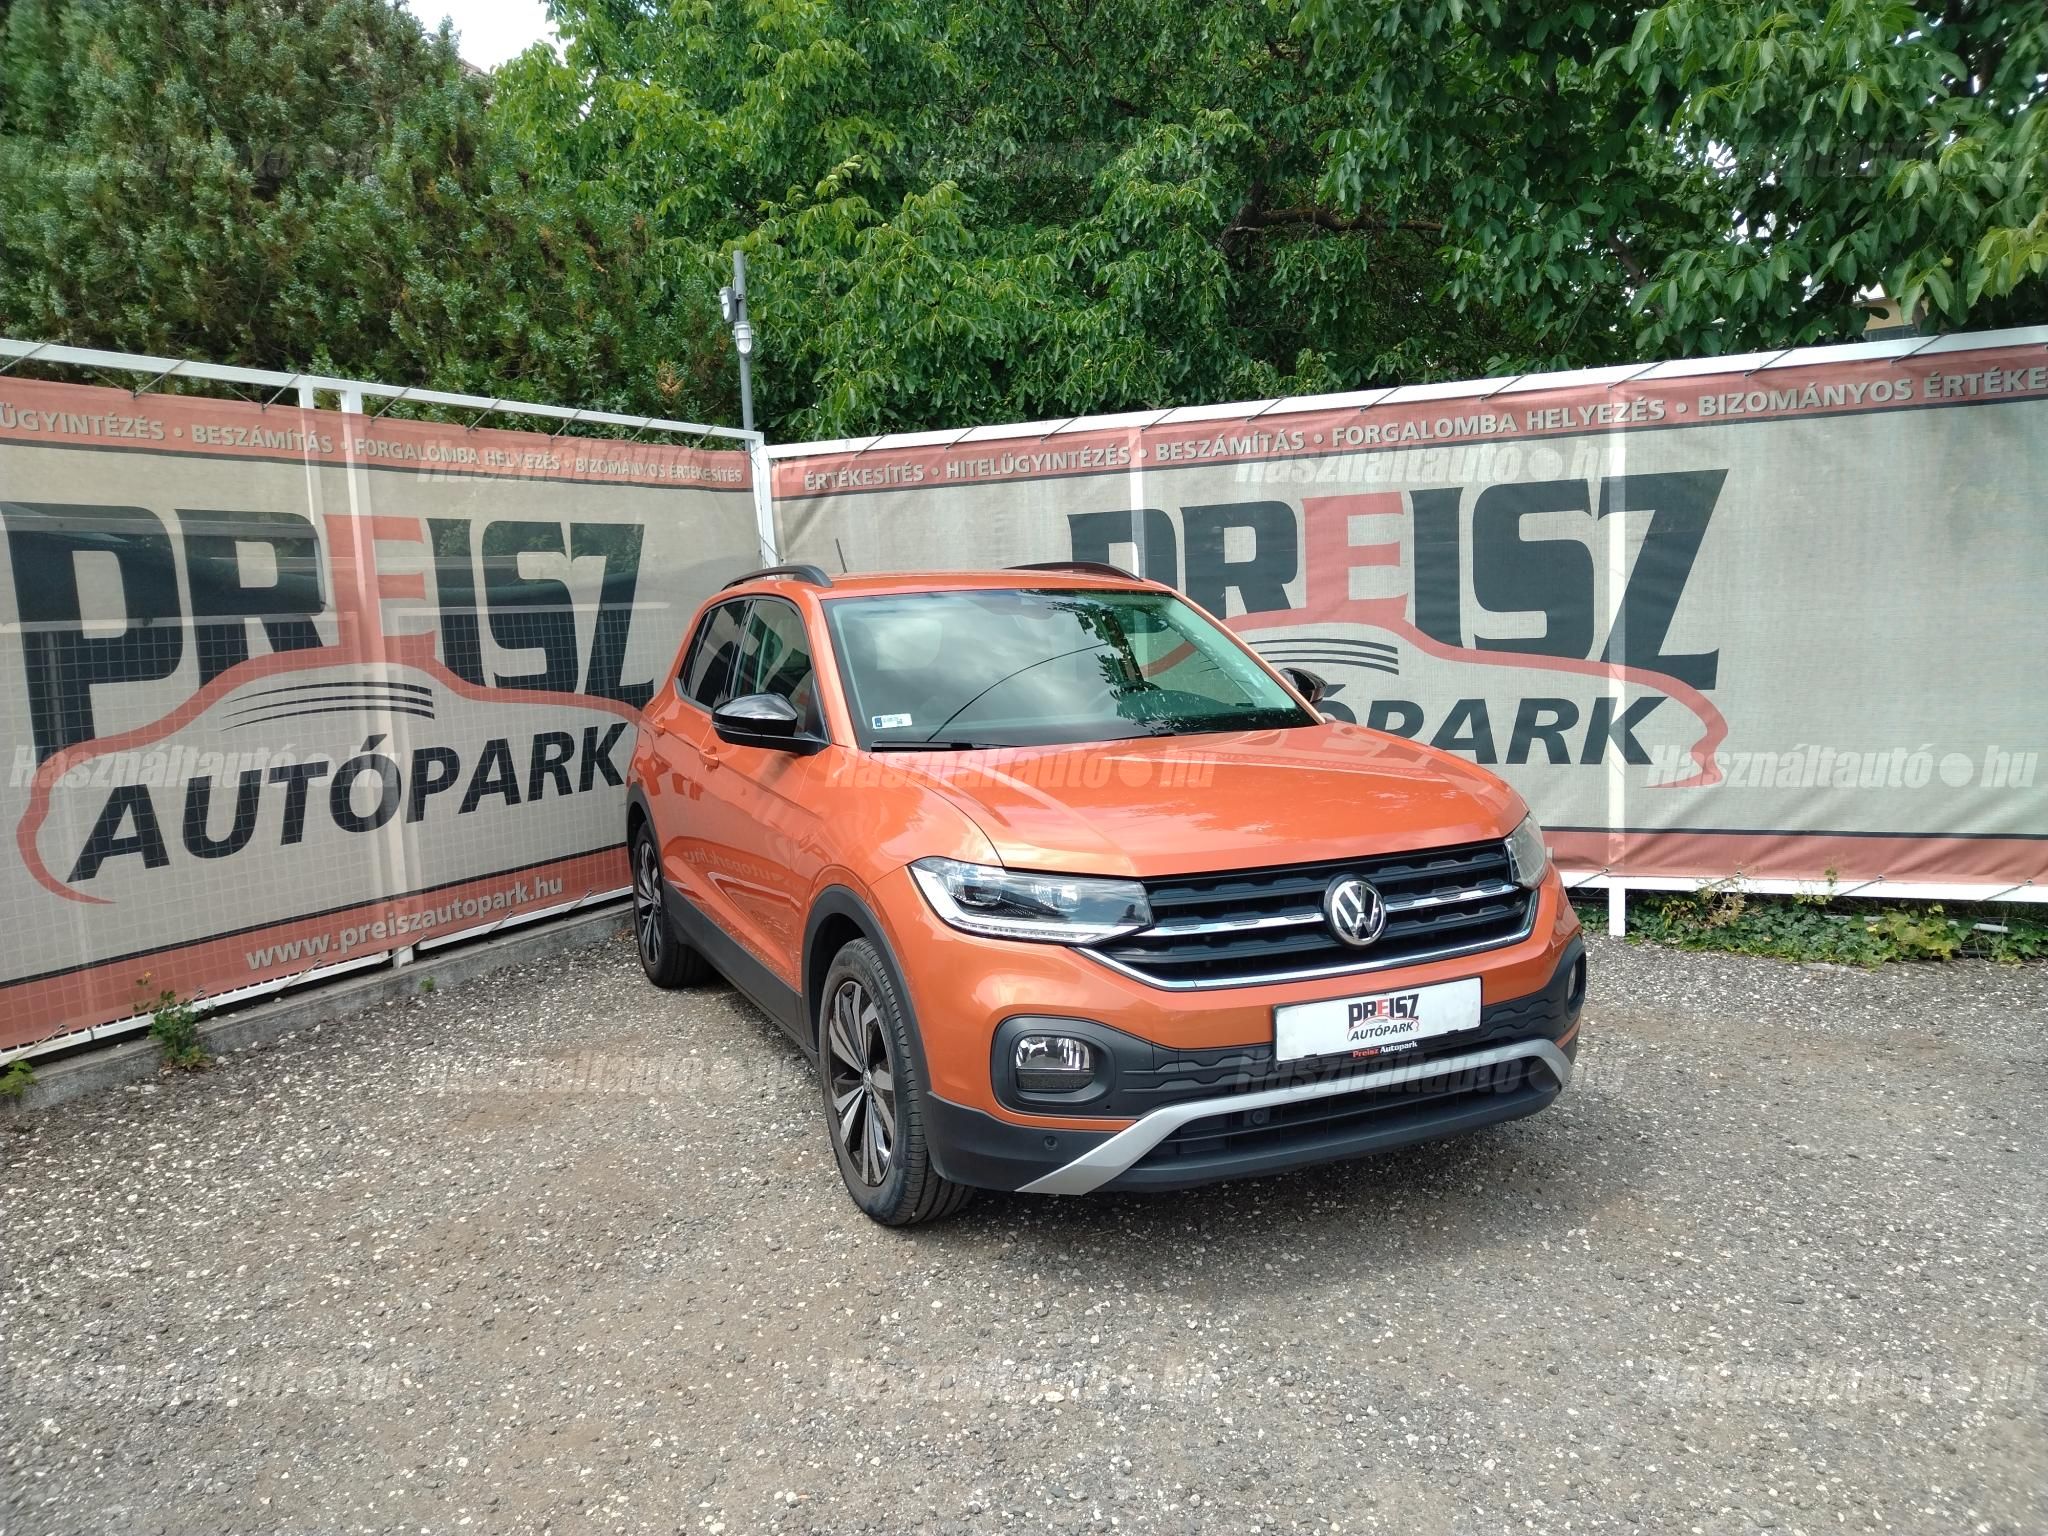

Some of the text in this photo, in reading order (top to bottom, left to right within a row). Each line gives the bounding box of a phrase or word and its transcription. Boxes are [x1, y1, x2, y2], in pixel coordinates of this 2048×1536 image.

[0, 401, 165, 441] ÜGYINTÉZÉS
[191, 424, 335, 454] BESZÁMÍTÁS
[354, 437, 480, 467] FORGALOMBA
[484, 447, 562, 471] HELYEZÉS
[574, 455, 666, 478] BIZOMÁNYOS
[803, 463, 924, 491] ÉRTÉKESÍTÉS
[945, 445, 1131, 480] HITELÜGYINTÉZÉS
[1155, 427, 1305, 461] BESZÁMÍTÁS
[1332, 413, 1518, 447] FORGALOMBA
[1526, 398, 1665, 431] HELYEZÉS
[1698, 378, 1913, 417] BIZOMÁNYOS
[2, 502, 654, 765] PREISZ
[66, 722, 632, 883] AUTÓPARK
[244, 875, 564, 971] www.preiszautopark.hu
[1347, 993, 1420, 1030] PREISZ
[1350, 1021, 1415, 1042] AUTÓPARK
[1352, 1040, 1418, 1058] Preisz Autopark
